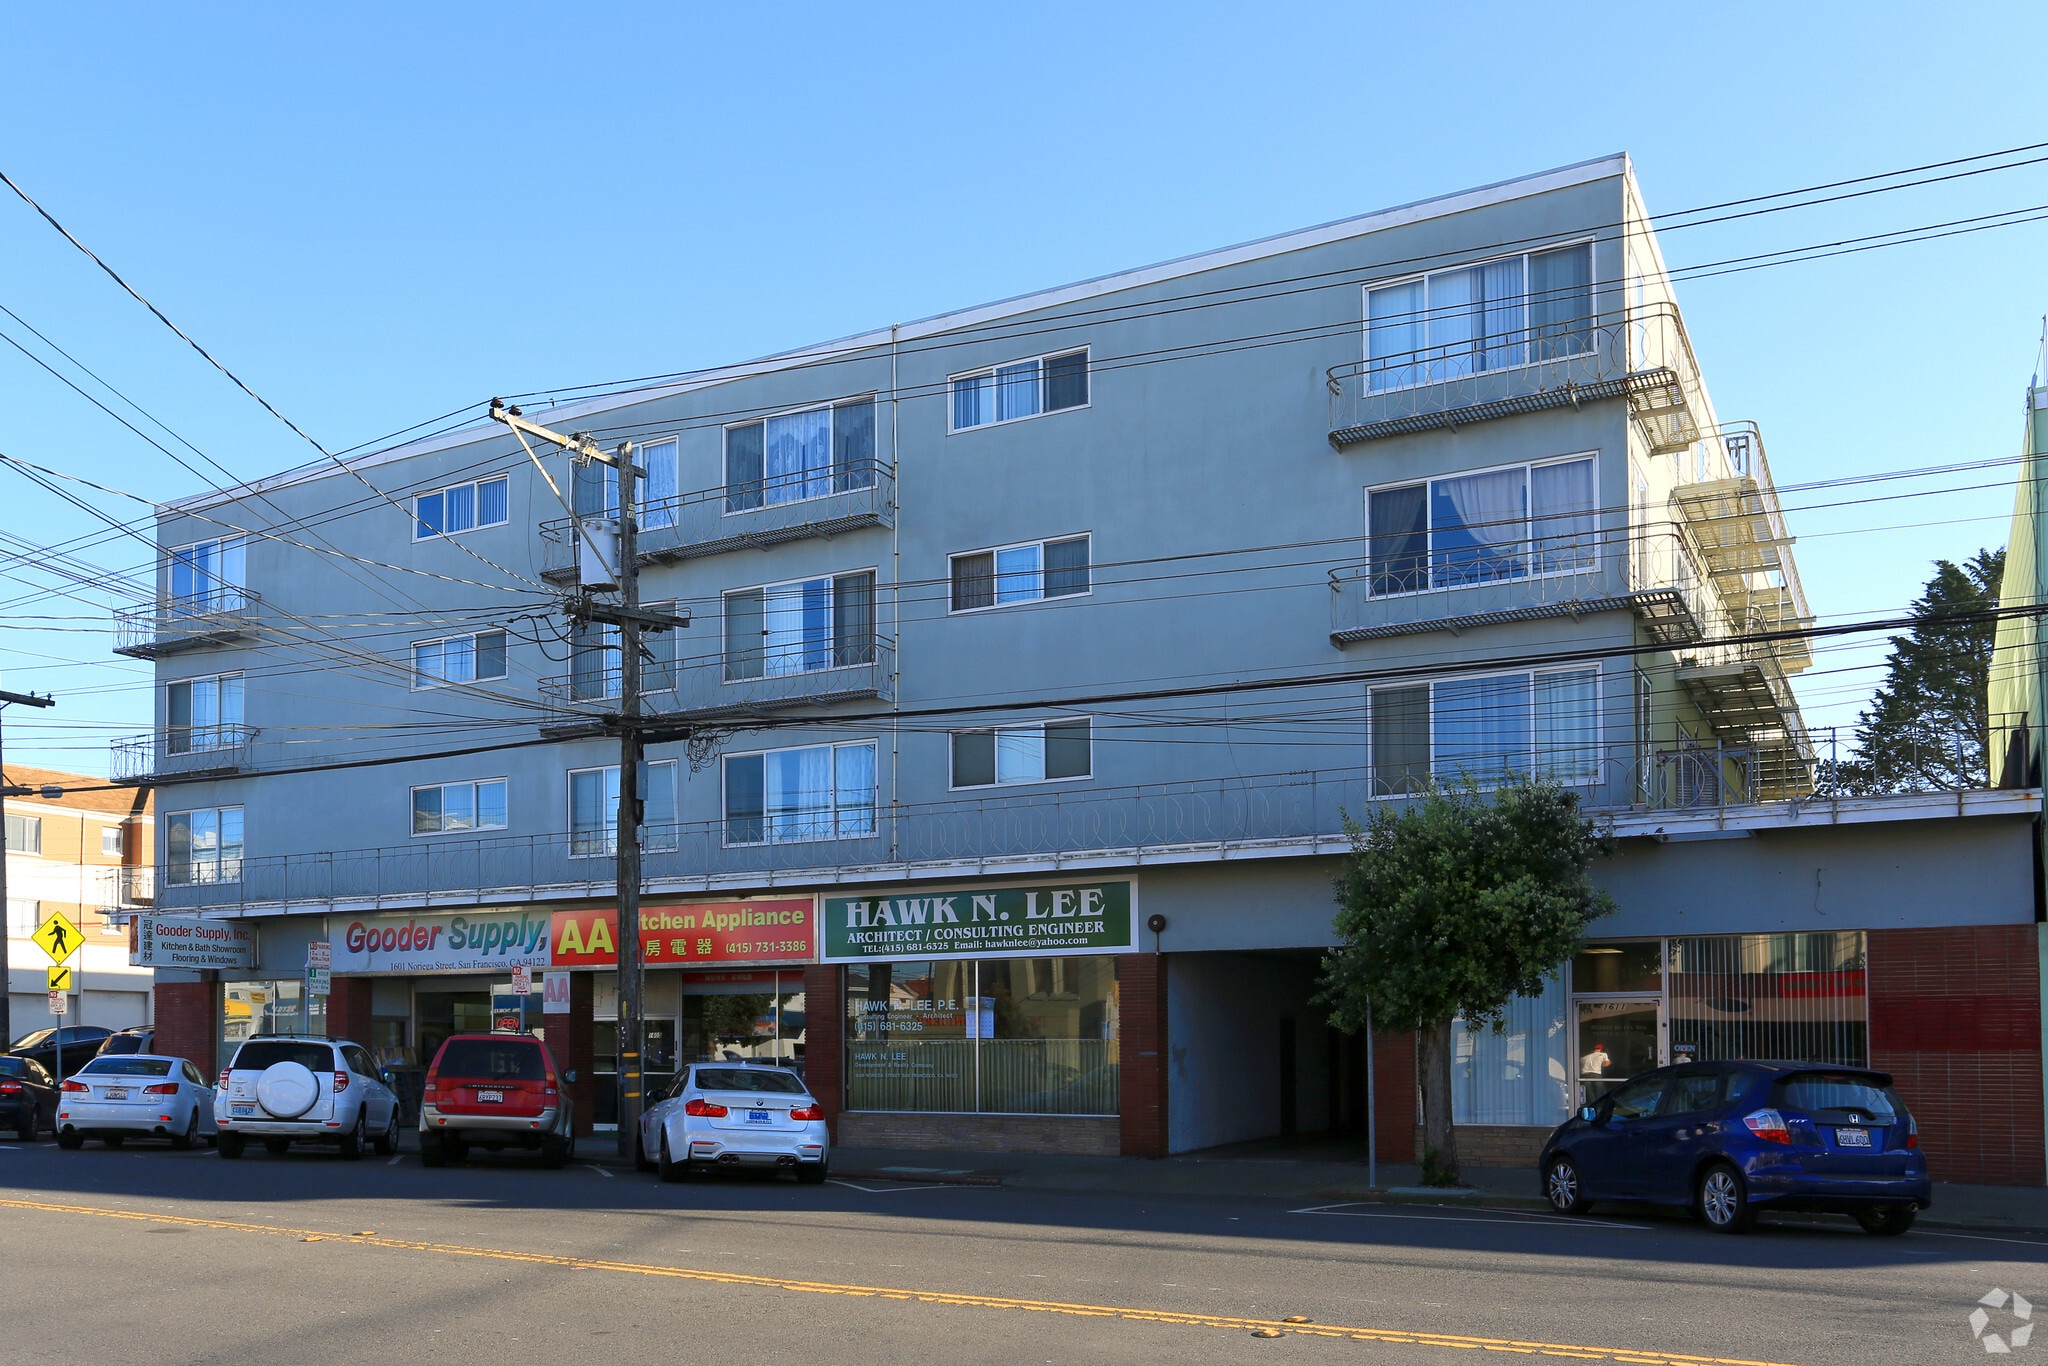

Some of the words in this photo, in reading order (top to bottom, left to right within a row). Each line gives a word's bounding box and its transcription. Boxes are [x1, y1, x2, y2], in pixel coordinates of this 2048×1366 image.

[845, 897, 960, 928] HAWK
[971, 894, 1010, 922] N.
[1025, 888, 1106, 919] LEE
[638, 910, 696, 931] tchen
[701, 907, 805, 932] Appliance
[155, 923, 193, 937] Gooder
[195, 926, 232, 942] Supply,
[233, 927, 251, 941] Inc.
[346, 919, 443, 953] Gooder
[448, 913, 548, 956] Supply,
[557, 918, 615, 955] AA
[847, 930, 923, 944] ARCHITECT
[925, 929, 931, 942] /
[934, 925, 1024, 940] CONSULTING
[1028, 920, 1105, 936] ENGINEER
[161, 941, 188, 952] Kitchen
[188, 943, 195, 952] &
[195, 943, 211, 953] Bath
[211, 944, 247, 955] Showroom
[645, 938, 713, 957] 房電器
[725, 941, 752, 954] (415)
[755, 940, 807, 953] 731-3386
[862, 944, 905, 954] TEL:(415)
[906, 941, 949, 952] 681-6325
[954, 940, 983, 950] Email:
[985, 937, 1089, 949] hawknlee@yahoo.com
[172, 953, 200, 965] Flooring
[200, 955, 207, 963] &
[207, 955, 238, 965] Windows
[390, 962, 405, 971] 1601
[407, 961, 434, 971] Noriega
[458, 959, 471, 970] San
[543, 978, 570, 1003] AA
[855, 1000, 888, 1011] HAWK
[894, 1000, 905, 1011] N.
[910, 999, 936, 1012] LEE,
[938, 999, 959, 1011] P.E.
[1603, 1003, 1626, 1011] 1611
[496, 1017, 520, 1029] OPEN
[854, 1021, 877, 1031] (415)
[880, 1021, 923, 1031] 681-6325
[1674, 1044, 1696, 1052] OPEN
